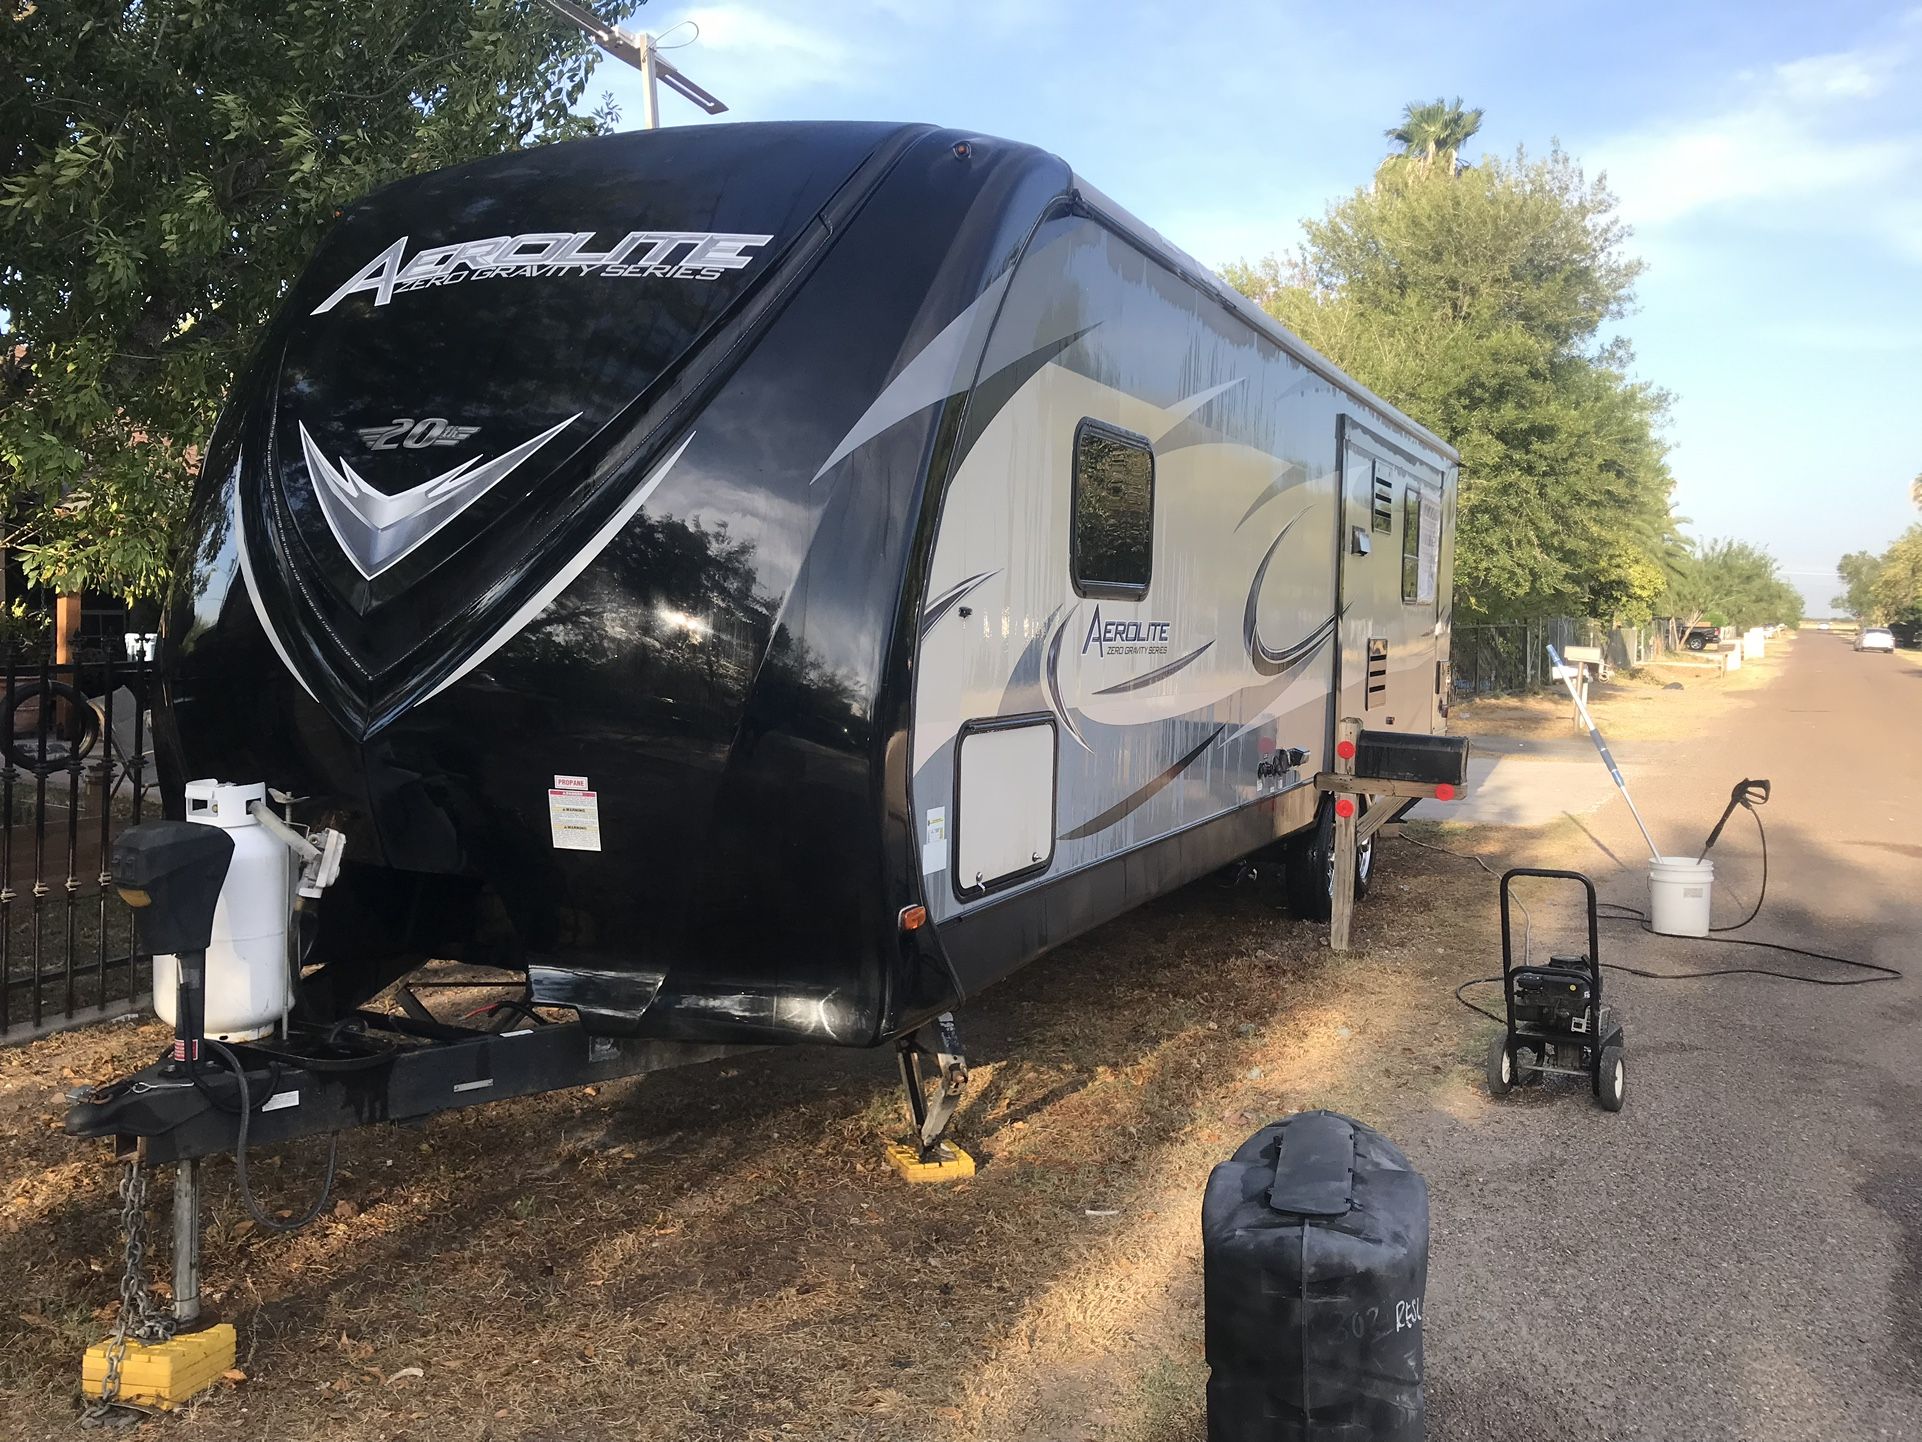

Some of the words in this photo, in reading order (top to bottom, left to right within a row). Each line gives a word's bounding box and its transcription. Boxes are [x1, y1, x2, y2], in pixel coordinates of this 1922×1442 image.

[310, 231, 775, 316] AEROLITE
[393, 270, 469, 294] ZERO
[471, 264, 602, 281] GRAVITY
[600, 264, 725, 281] SERIES
[1081, 603, 1170, 658] AEROLITE
[1107, 646, 1123, 655] ZERO
[1124, 646, 1148, 655] GRAVITY
[1148, 646, 1167, 655] SERIES
[558, 779, 584, 787] PROPANE
